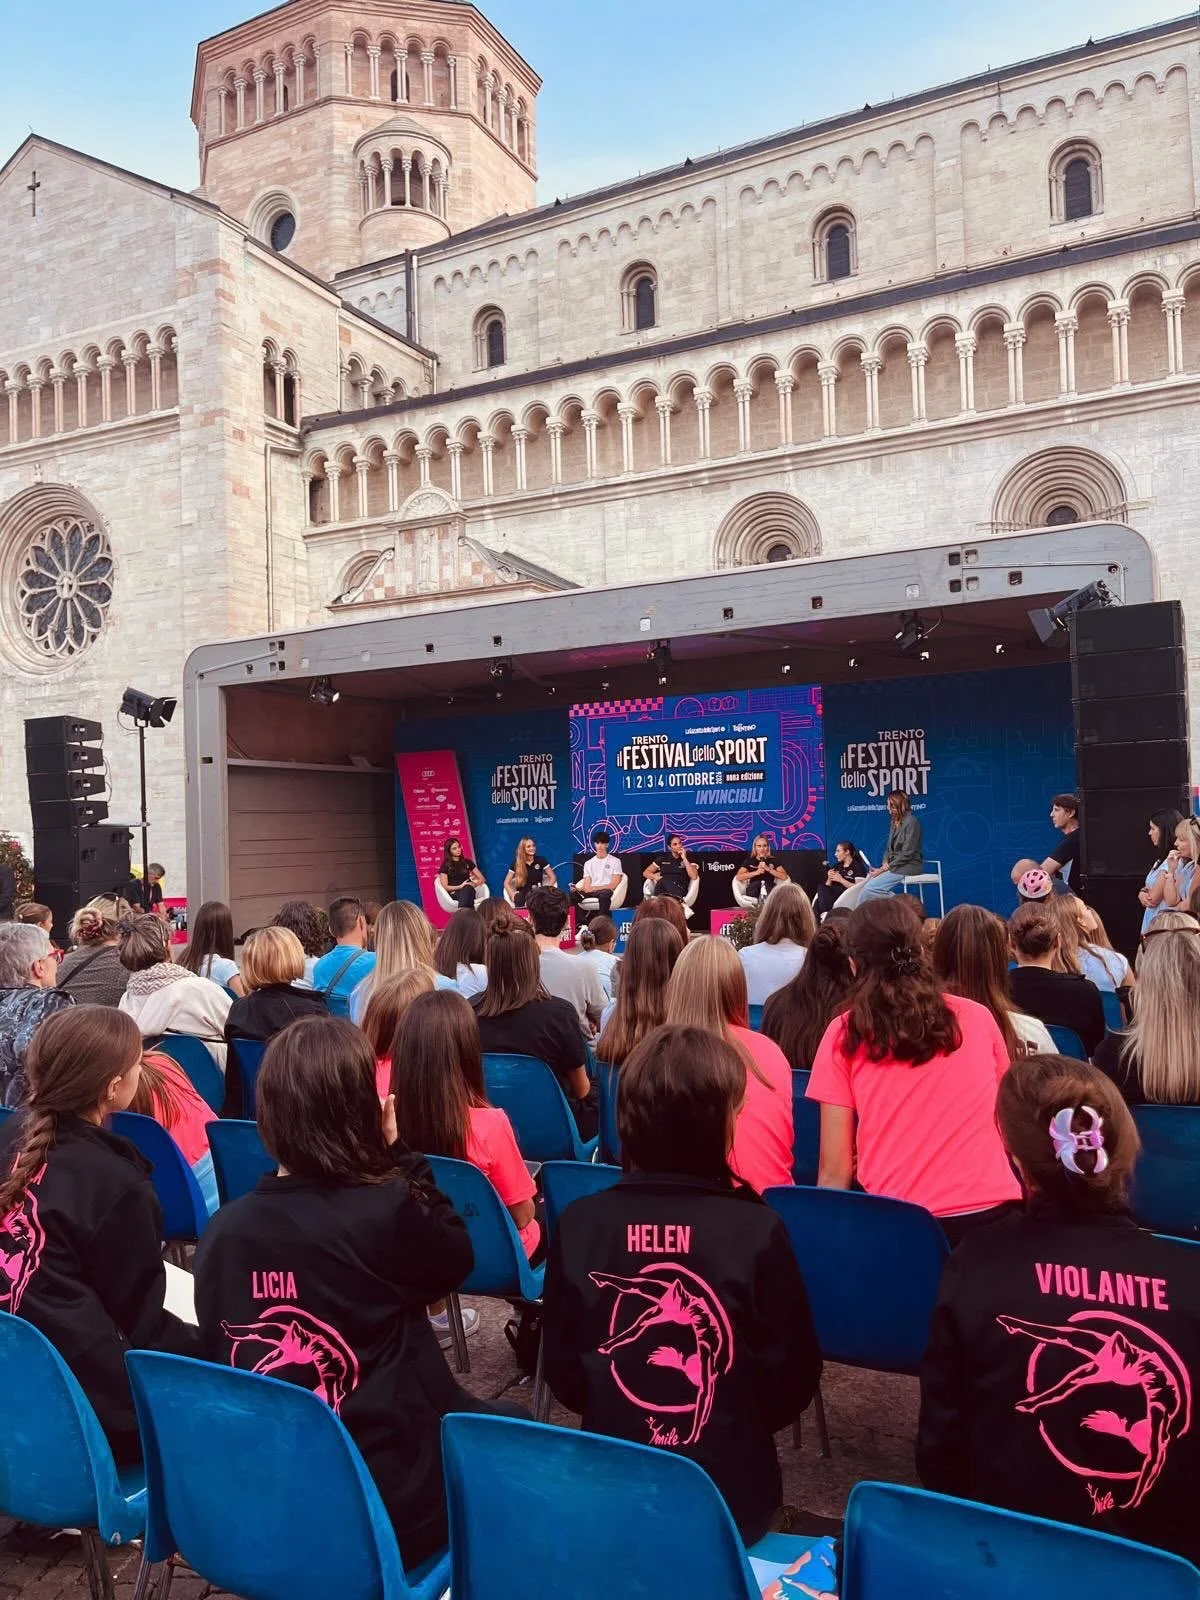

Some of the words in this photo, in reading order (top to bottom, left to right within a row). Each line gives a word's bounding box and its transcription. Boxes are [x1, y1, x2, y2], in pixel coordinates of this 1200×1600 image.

[632, 734, 668, 745] TRENTO
[877, 728, 925, 740] TRENTO
[519, 753, 553, 764] TRENTO
[623, 742, 695, 770] FESTIVAL
[715, 737, 768, 765] SPORT
[847, 740, 931, 769] FESTIVAL
[497, 763, 558, 788] FESTIVAL
[668, 771, 715, 787] OTTOBRE
[840, 771, 866, 789] dello
[867, 766, 931, 797] SPORT
[491, 789, 511, 804] dello
[511, 785, 558, 811] SPORT
[695, 787, 764, 805] INVINCIBILI
[627, 1225, 691, 1253] HELEN
[252, 1271, 298, 1299] LICIA
[1035, 1262, 1169, 1311] VIOLANTE
